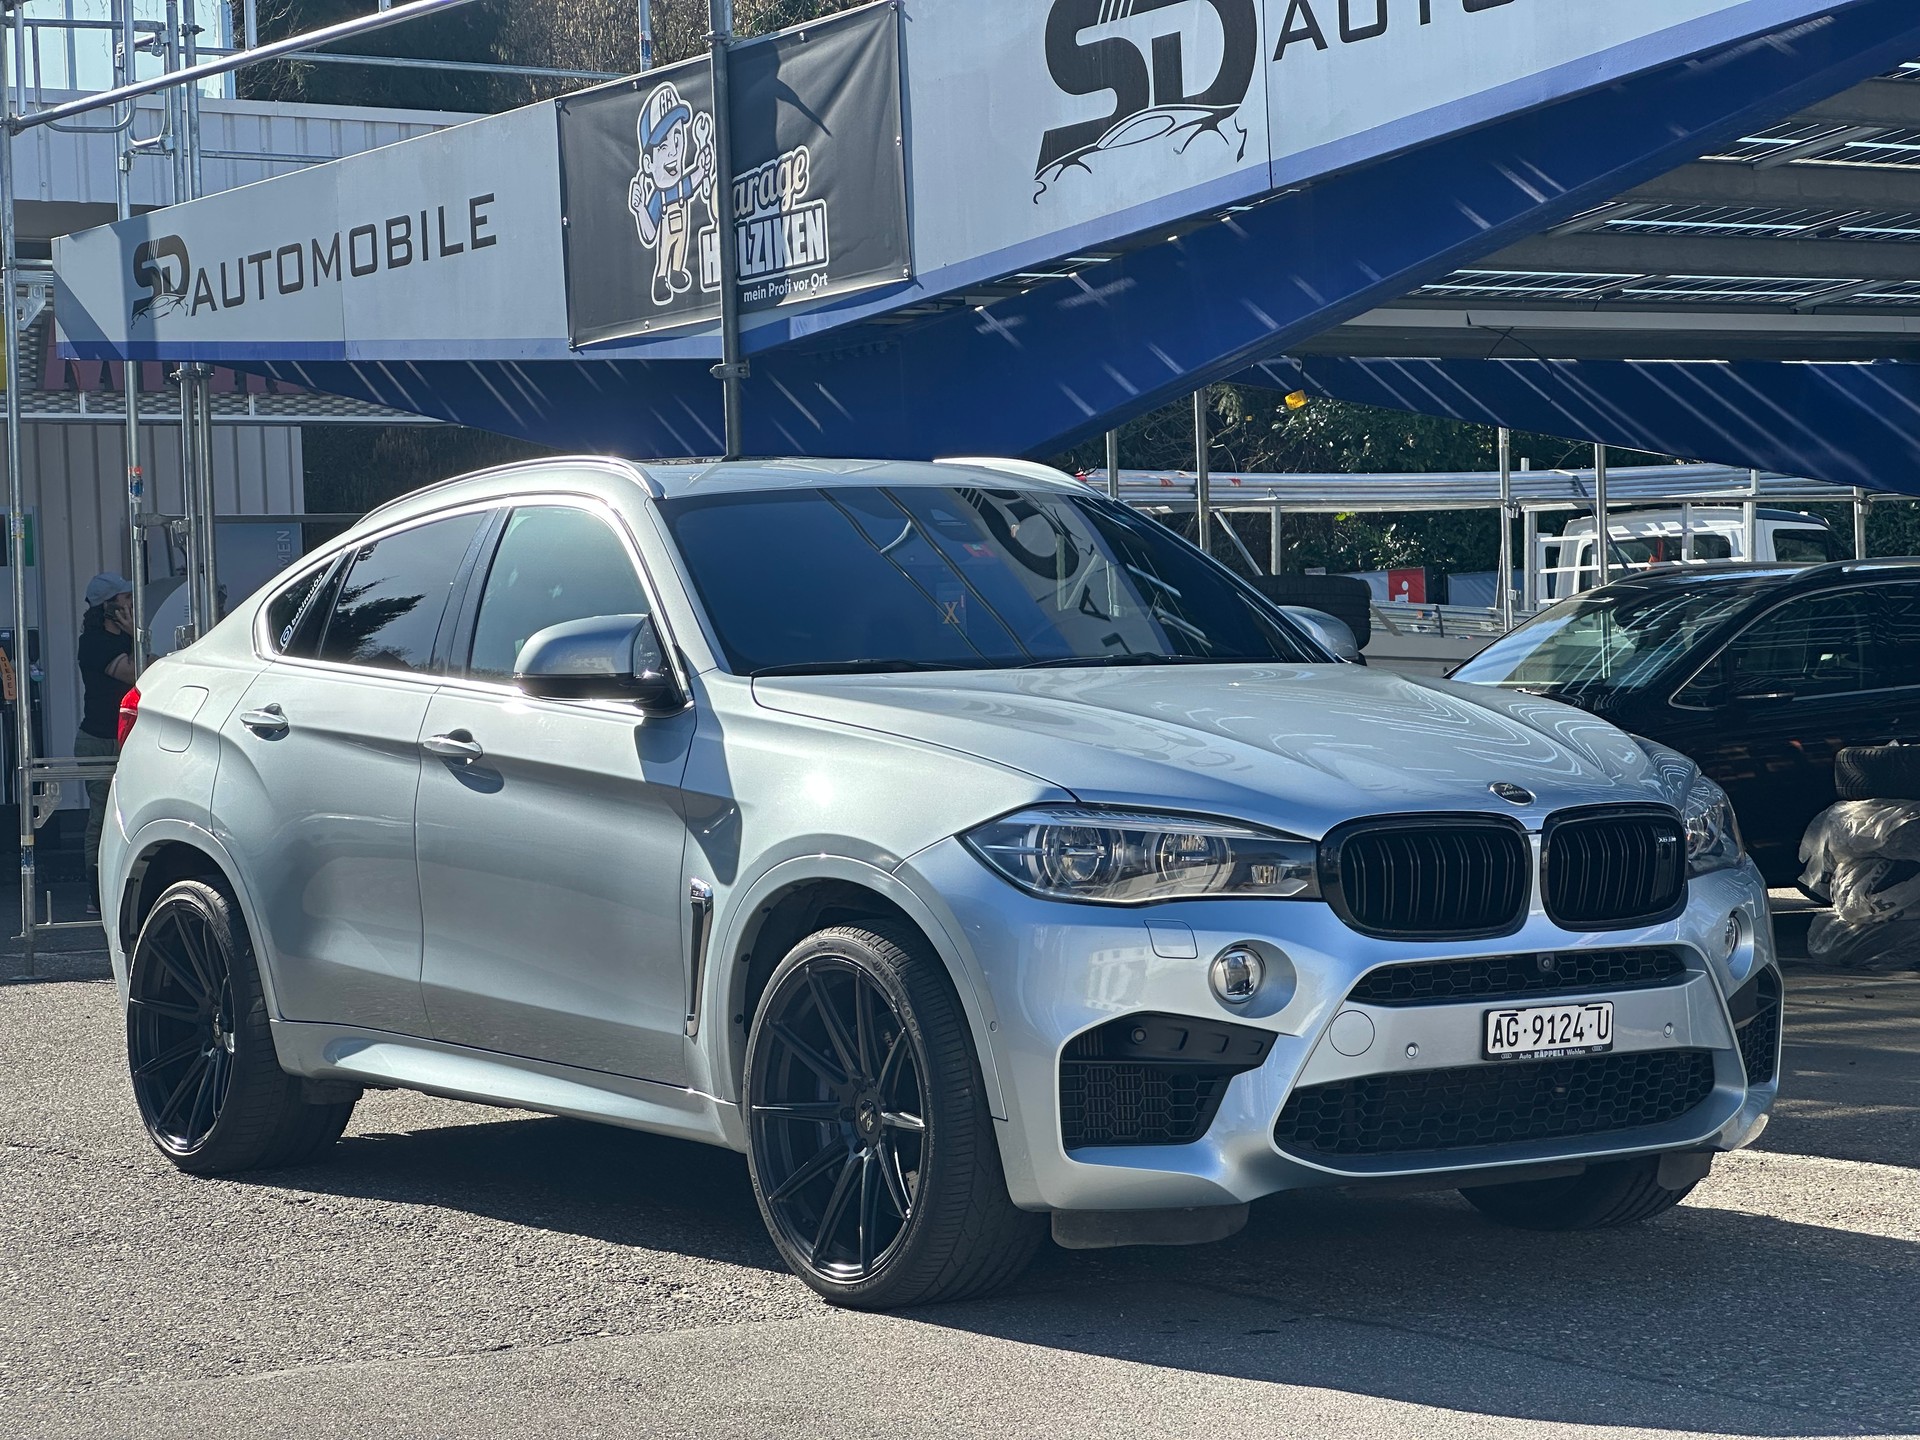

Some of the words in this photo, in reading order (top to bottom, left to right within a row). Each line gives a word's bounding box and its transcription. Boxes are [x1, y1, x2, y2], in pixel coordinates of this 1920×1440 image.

[1273, 0, 1515, 62] AU
[712, 153, 806, 218] arage
[191, 193, 497, 317] AUTOMOBILE
[702, 207, 825, 285] HLZIKEN
[743, 285, 767, 302] mein
[769, 279, 792, 298] Profi
[793, 280, 809, 292] vor
[811, 273, 828, 288] Ort
